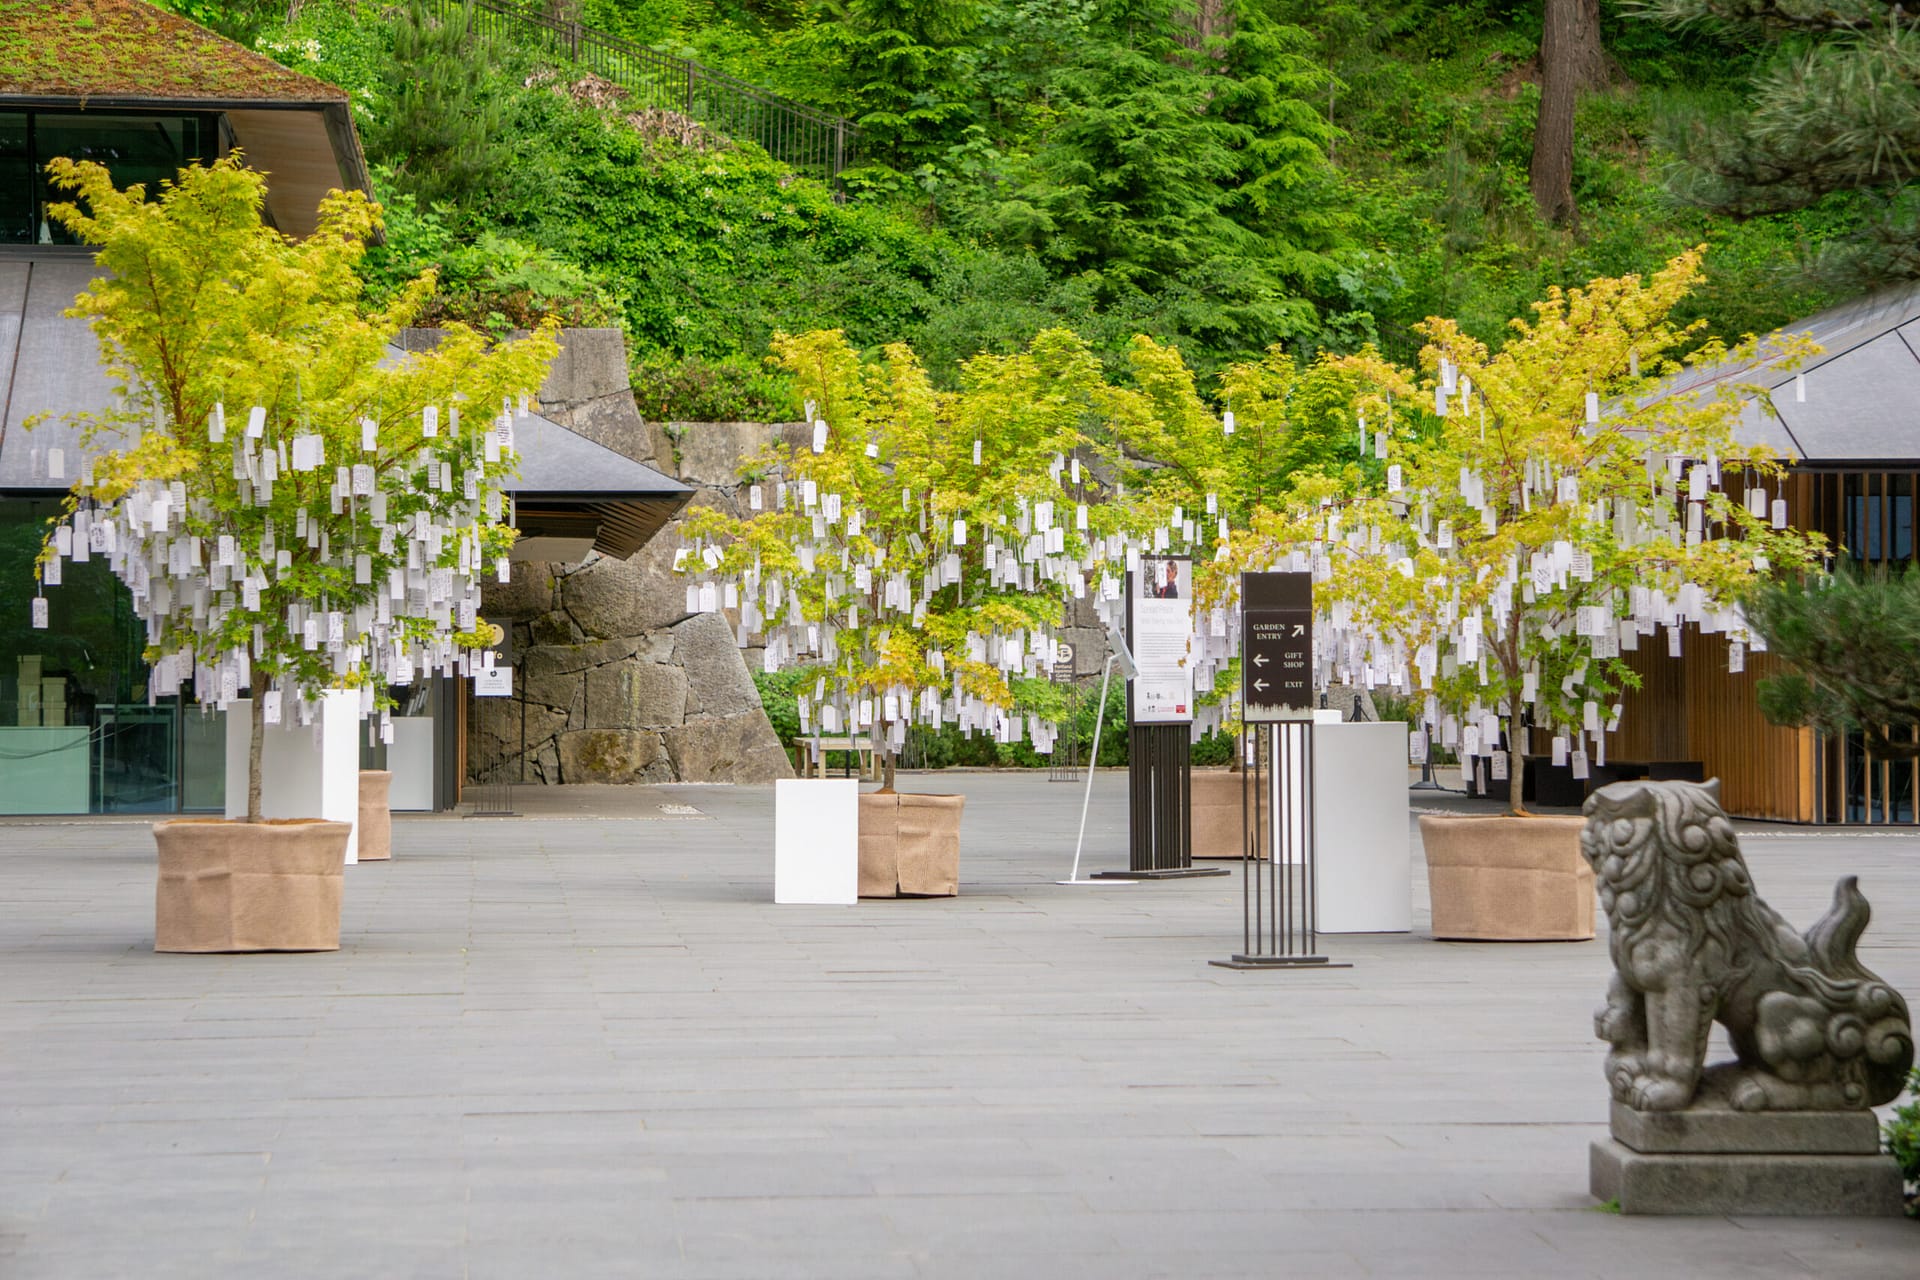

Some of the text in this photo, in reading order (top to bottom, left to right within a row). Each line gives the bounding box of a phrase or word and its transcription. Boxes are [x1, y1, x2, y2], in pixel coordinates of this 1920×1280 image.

[1253, 623, 1285, 631] GARDEN
[1284, 651, 1303, 659] GIFT
[1284, 681, 1304, 689] EXIT
